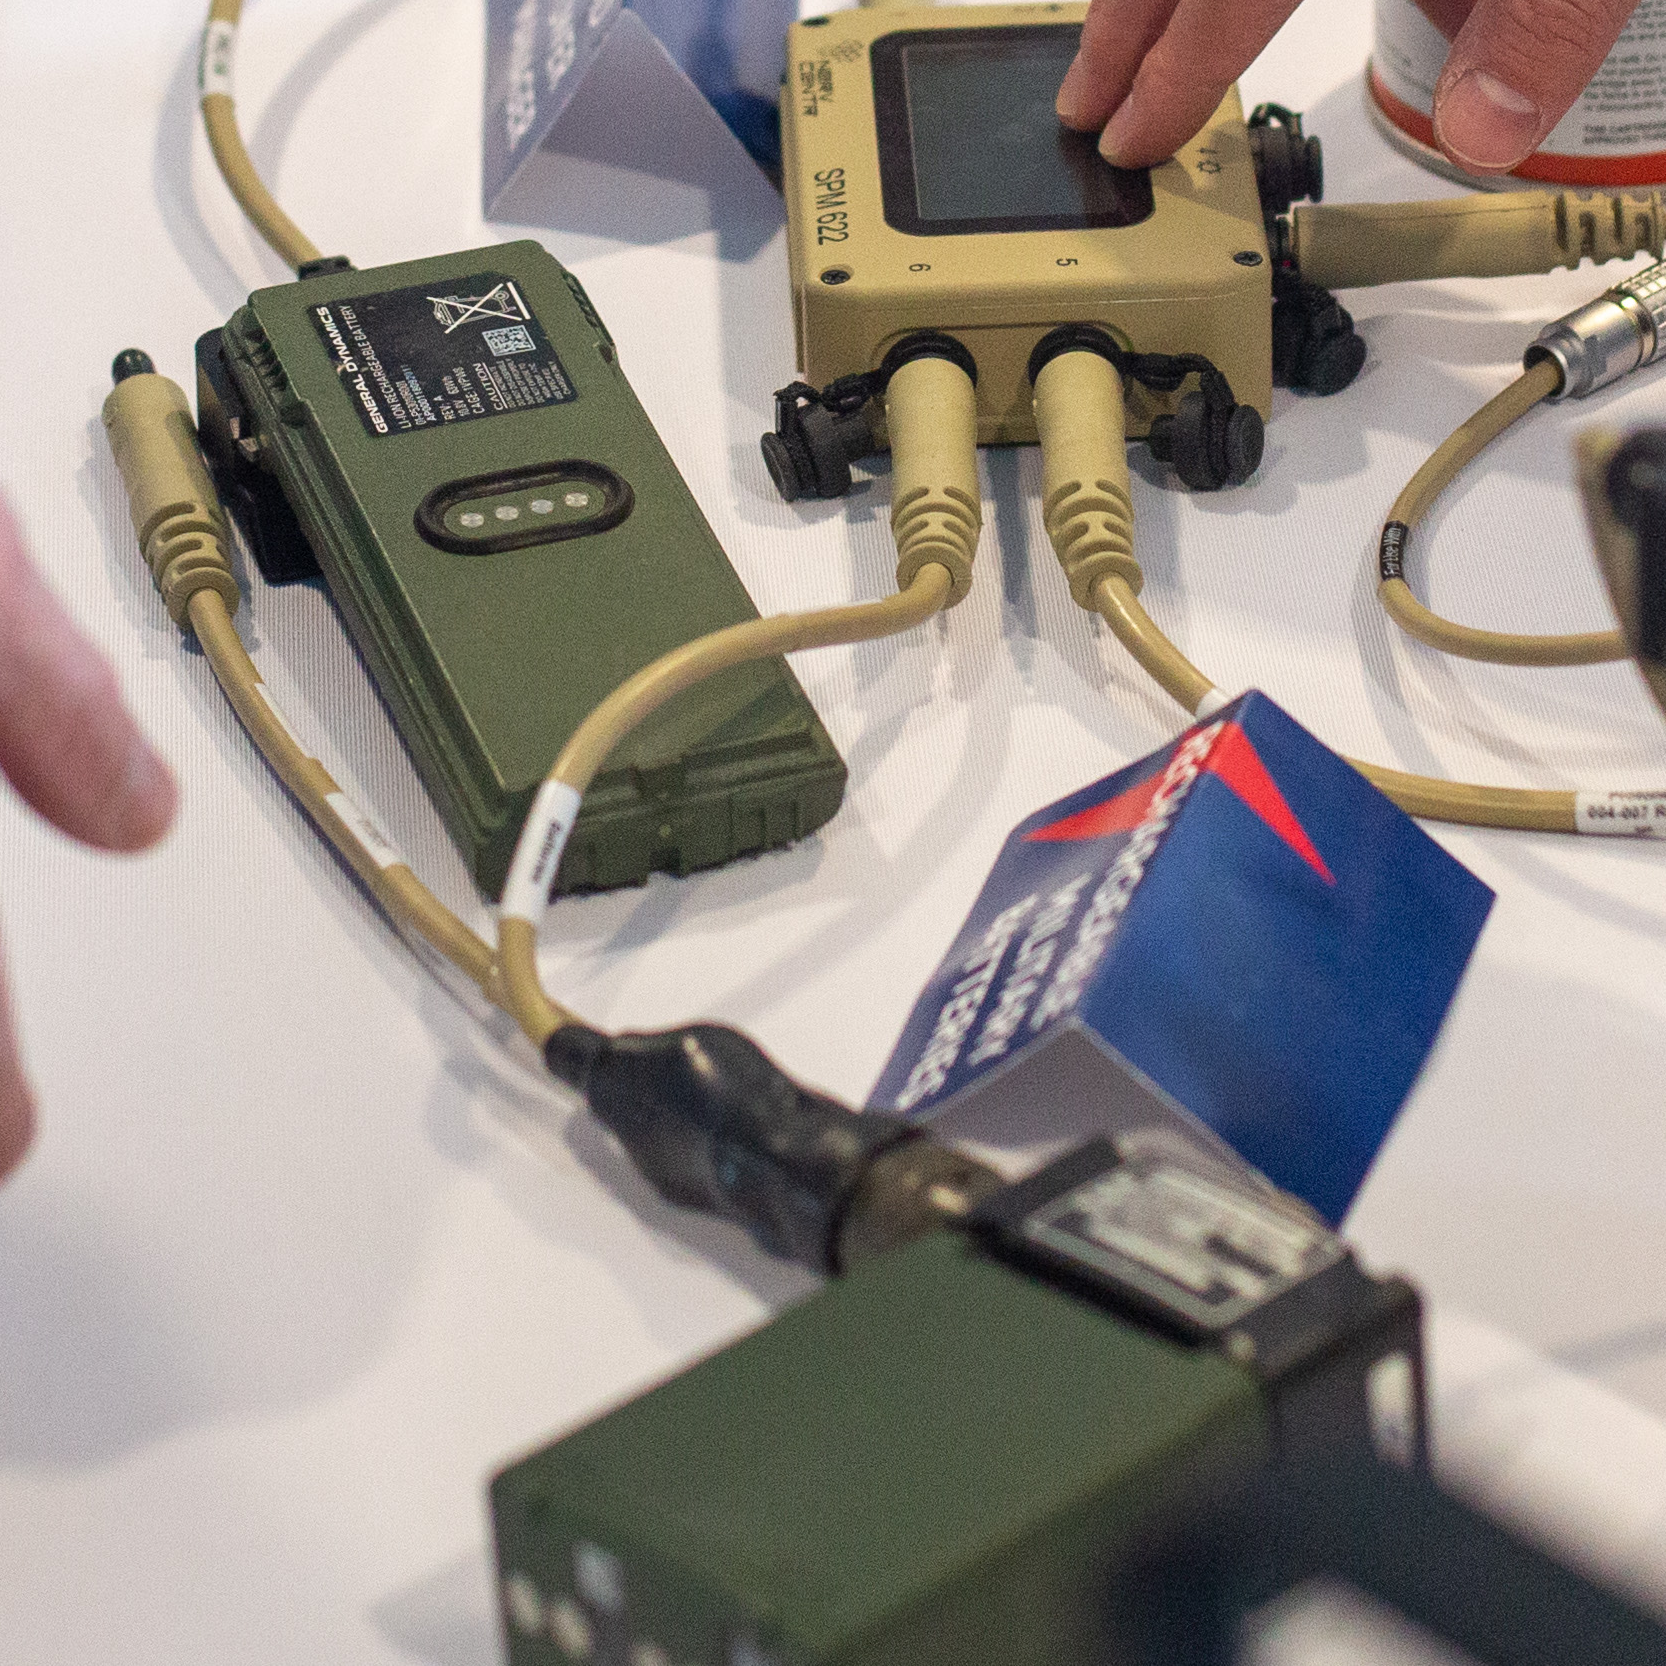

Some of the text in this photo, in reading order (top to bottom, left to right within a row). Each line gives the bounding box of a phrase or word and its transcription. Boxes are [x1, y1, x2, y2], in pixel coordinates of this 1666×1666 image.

[814, 168, 849, 246] SPM 622
[315, 305, 389, 433] GENERAL DYNAMICS
[338, 304, 411, 428] LI-ION RECHARGEABLE BATTERY
[471, 362, 504, 410] CAUTION
